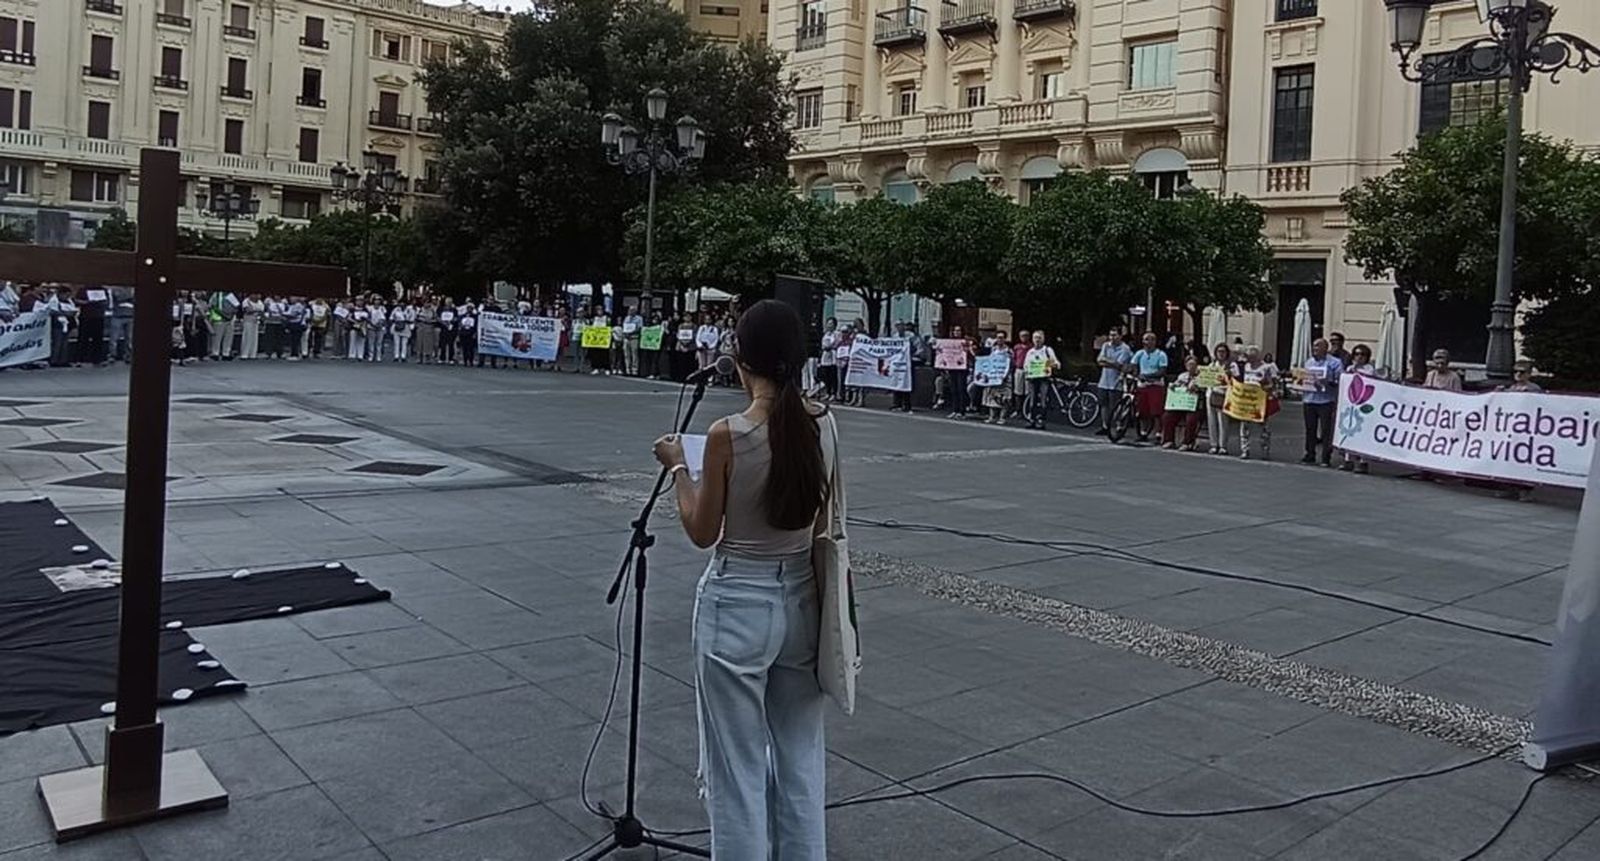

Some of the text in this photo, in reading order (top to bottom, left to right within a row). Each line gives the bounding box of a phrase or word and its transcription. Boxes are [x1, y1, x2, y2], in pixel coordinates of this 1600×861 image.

[1380, 401, 1462, 430] cuidar
[1464, 405, 1488, 432] el
[1374, 424, 1557, 468] cuidar la vida
